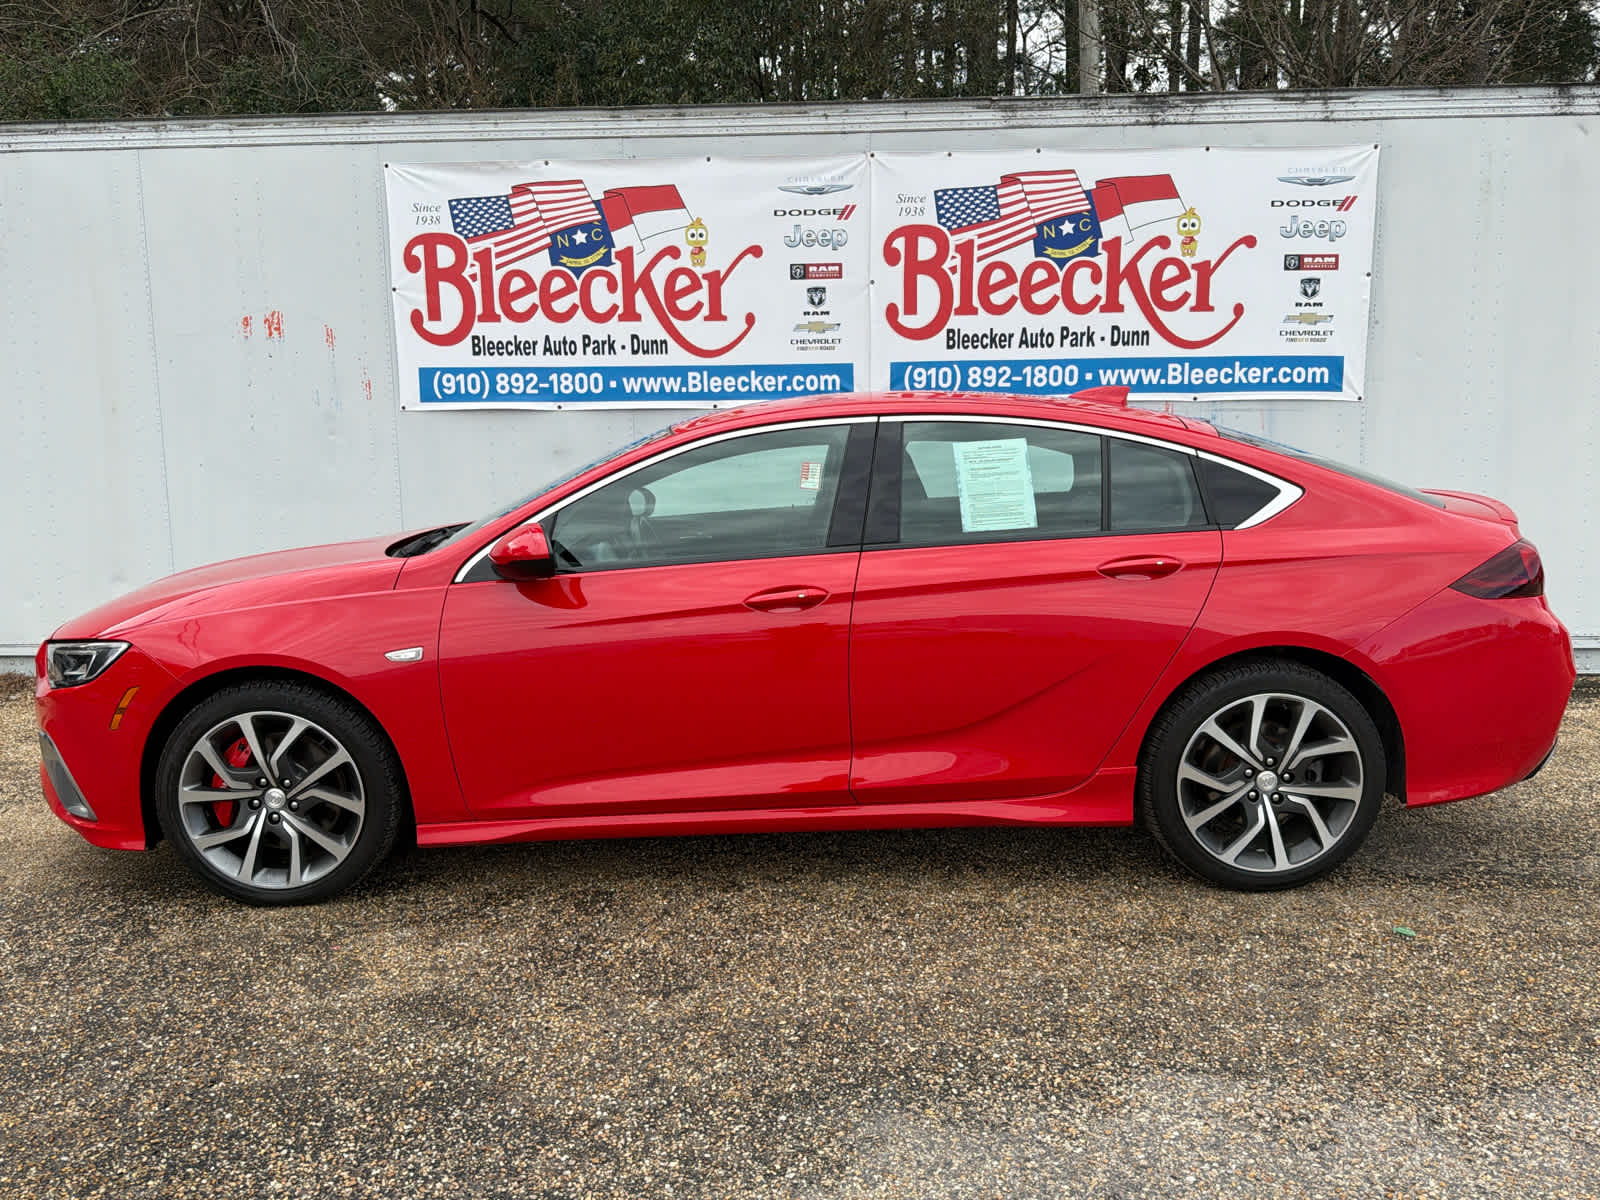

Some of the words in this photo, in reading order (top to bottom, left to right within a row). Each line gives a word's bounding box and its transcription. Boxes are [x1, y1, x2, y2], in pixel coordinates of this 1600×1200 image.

[412, 202, 441, 213] Since
[896, 193, 926, 204] Since
[1271, 199, 1344, 207] DODGE
[416, 215, 441, 225] 1938
[774, 208, 844, 217] DODGE
[898, 206, 926, 216] 1938
[557, 233, 570, 248] N
[591, 228, 604, 241] C
[784, 224, 848, 251] Jeep
[1043, 224, 1056, 239] N
[1079, 218, 1092, 231] C
[1280, 215, 1347, 242] Jeep
[471, 335, 538, 357] Bleecker
[543, 335, 577, 356] Auto
[582, 334, 617, 355] Park
[630, 334, 668, 355] Dunn
[946, 327, 1014, 350] Bleecker
[1018, 327, 1055, 349] Auto
[1060, 326, 1096, 348] Park
[1110, 325, 1150, 346] Dunn
[433, 371, 490, 399] (910)
[495, 372, 604, 395] 892-1800
[622, 370, 841, 394] www.Bleecker.com
[904, 364, 961, 391] (910)
[967, 365, 1079, 388] 892-1800
[1099, 361, 1329, 386] www.Bleecker.com
